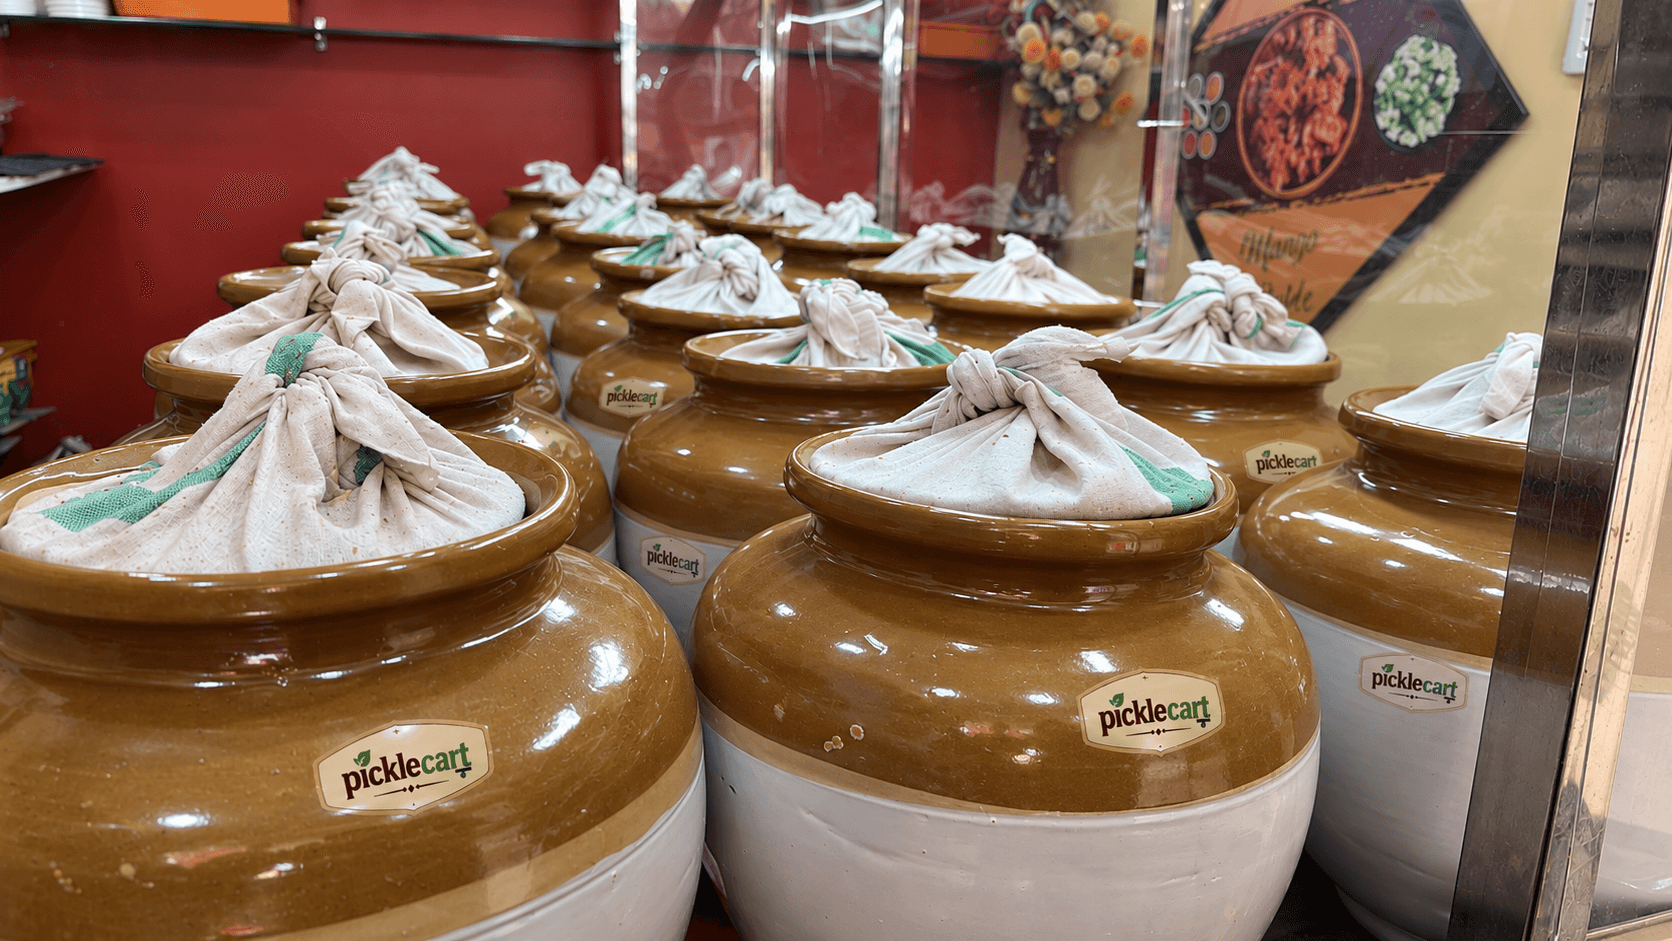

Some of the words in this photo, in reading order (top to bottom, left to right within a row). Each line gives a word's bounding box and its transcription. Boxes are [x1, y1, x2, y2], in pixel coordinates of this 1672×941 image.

[606, 385, 658, 406] picklecart
[1255, 450, 1317, 475] picklecart
[646, 544, 700, 573] picklecart
[1371, 664, 1458, 699] picklecart
[1098, 692, 1211, 737] picklecart
[341, 742, 472, 801] picklecart
